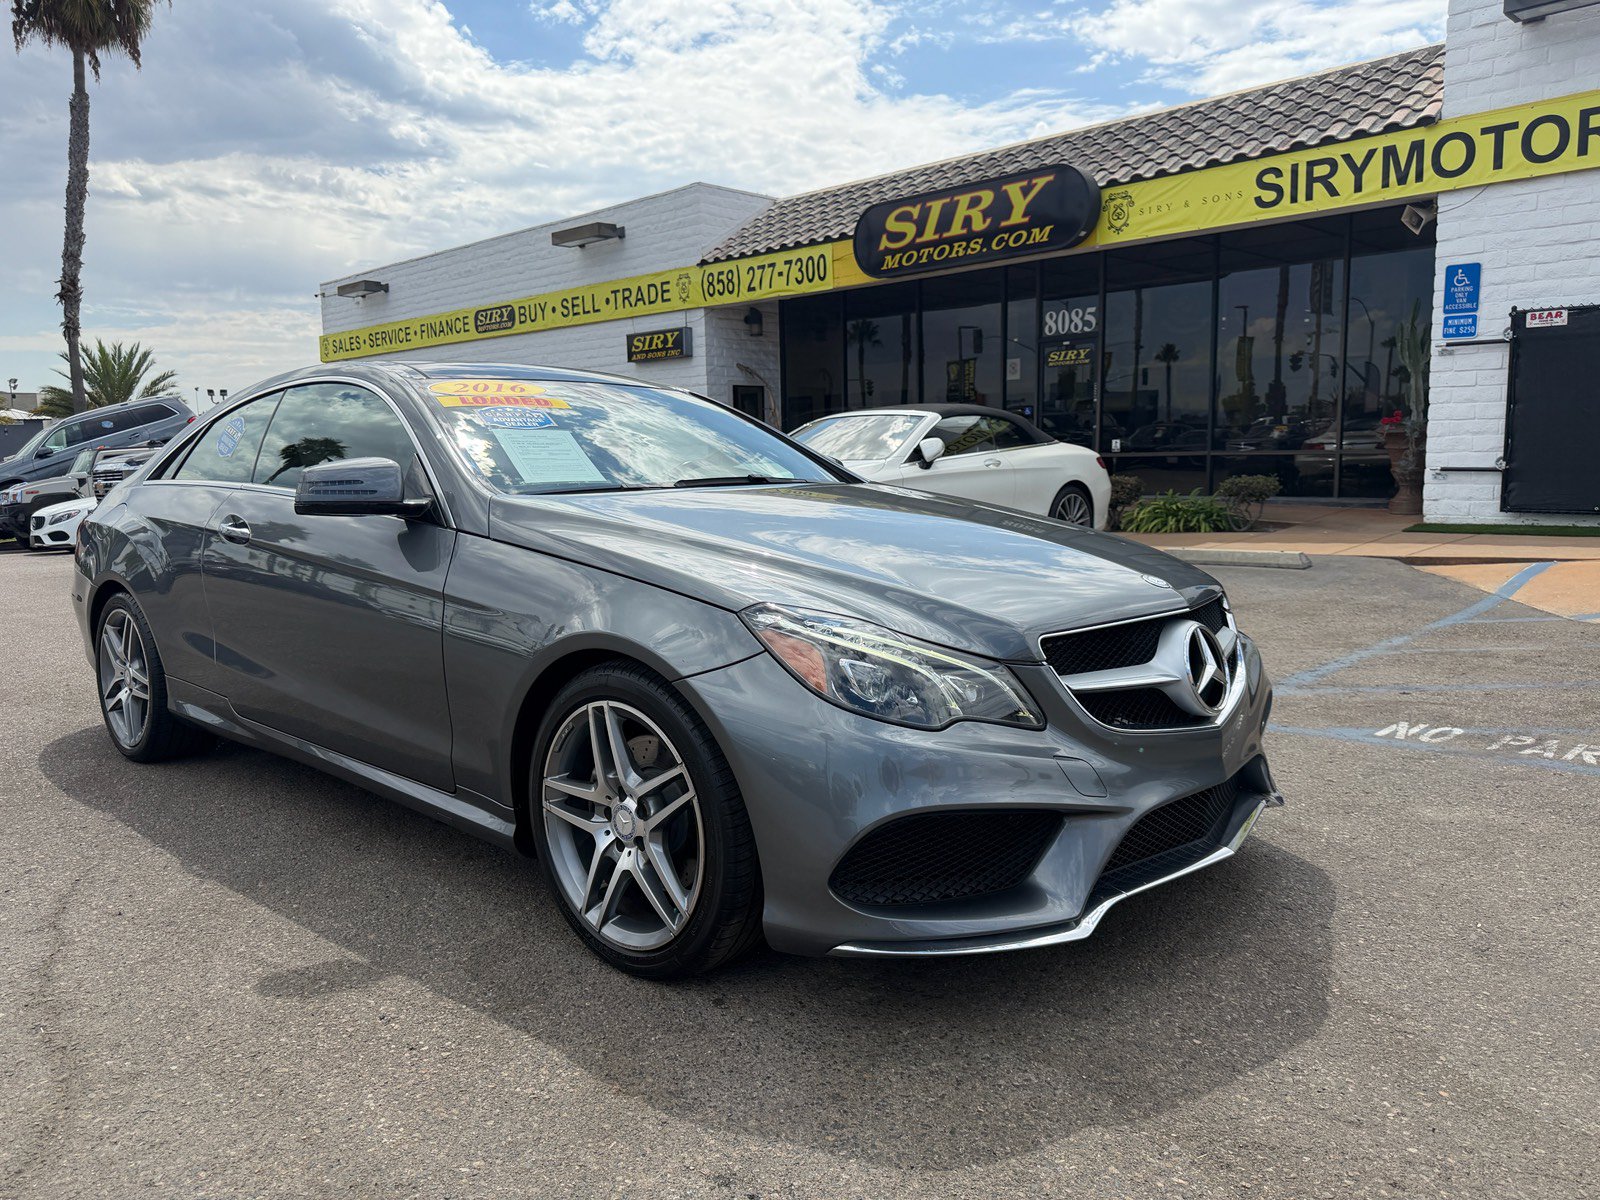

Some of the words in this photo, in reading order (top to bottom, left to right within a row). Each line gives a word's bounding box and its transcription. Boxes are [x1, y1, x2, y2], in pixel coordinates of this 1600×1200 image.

[878, 174, 1056, 250] SIRY
[1139, 203, 1173, 216] SIRY
[1183, 200, 1190, 208] &
[1202, 190, 1244, 205] SONS
[881, 224, 1055, 270] MOTORS.COM
[701, 265, 741, 302] (858)
[747, 253, 827, 293] 277-7300
[518, 301, 548, 324] BUY
[560, 293, 601, 318] SELL
[611, 281, 671, 310] TRADE
[477, 307, 512, 326] SIRY
[1044, 306, 1097, 336] 8085
[1448, 318, 1473, 326] MINIMUM
[1530, 311, 1563, 320] BEAR
[332, 336, 362, 354] SALES
[368, 326, 411, 349] SERVICE
[420, 315, 470, 340] FINANCE
[1459, 325, 1476, 334] $250
[632, 331, 680, 352] SIRY
[631, 353, 647, 361] AND
[647, 351, 666, 359] SONS
[1048, 348, 1091, 362] SIRY
[454, 382, 526, 394] 2016
[459, 396, 554, 407] LOADED
[1374, 721, 1464, 743] NO
